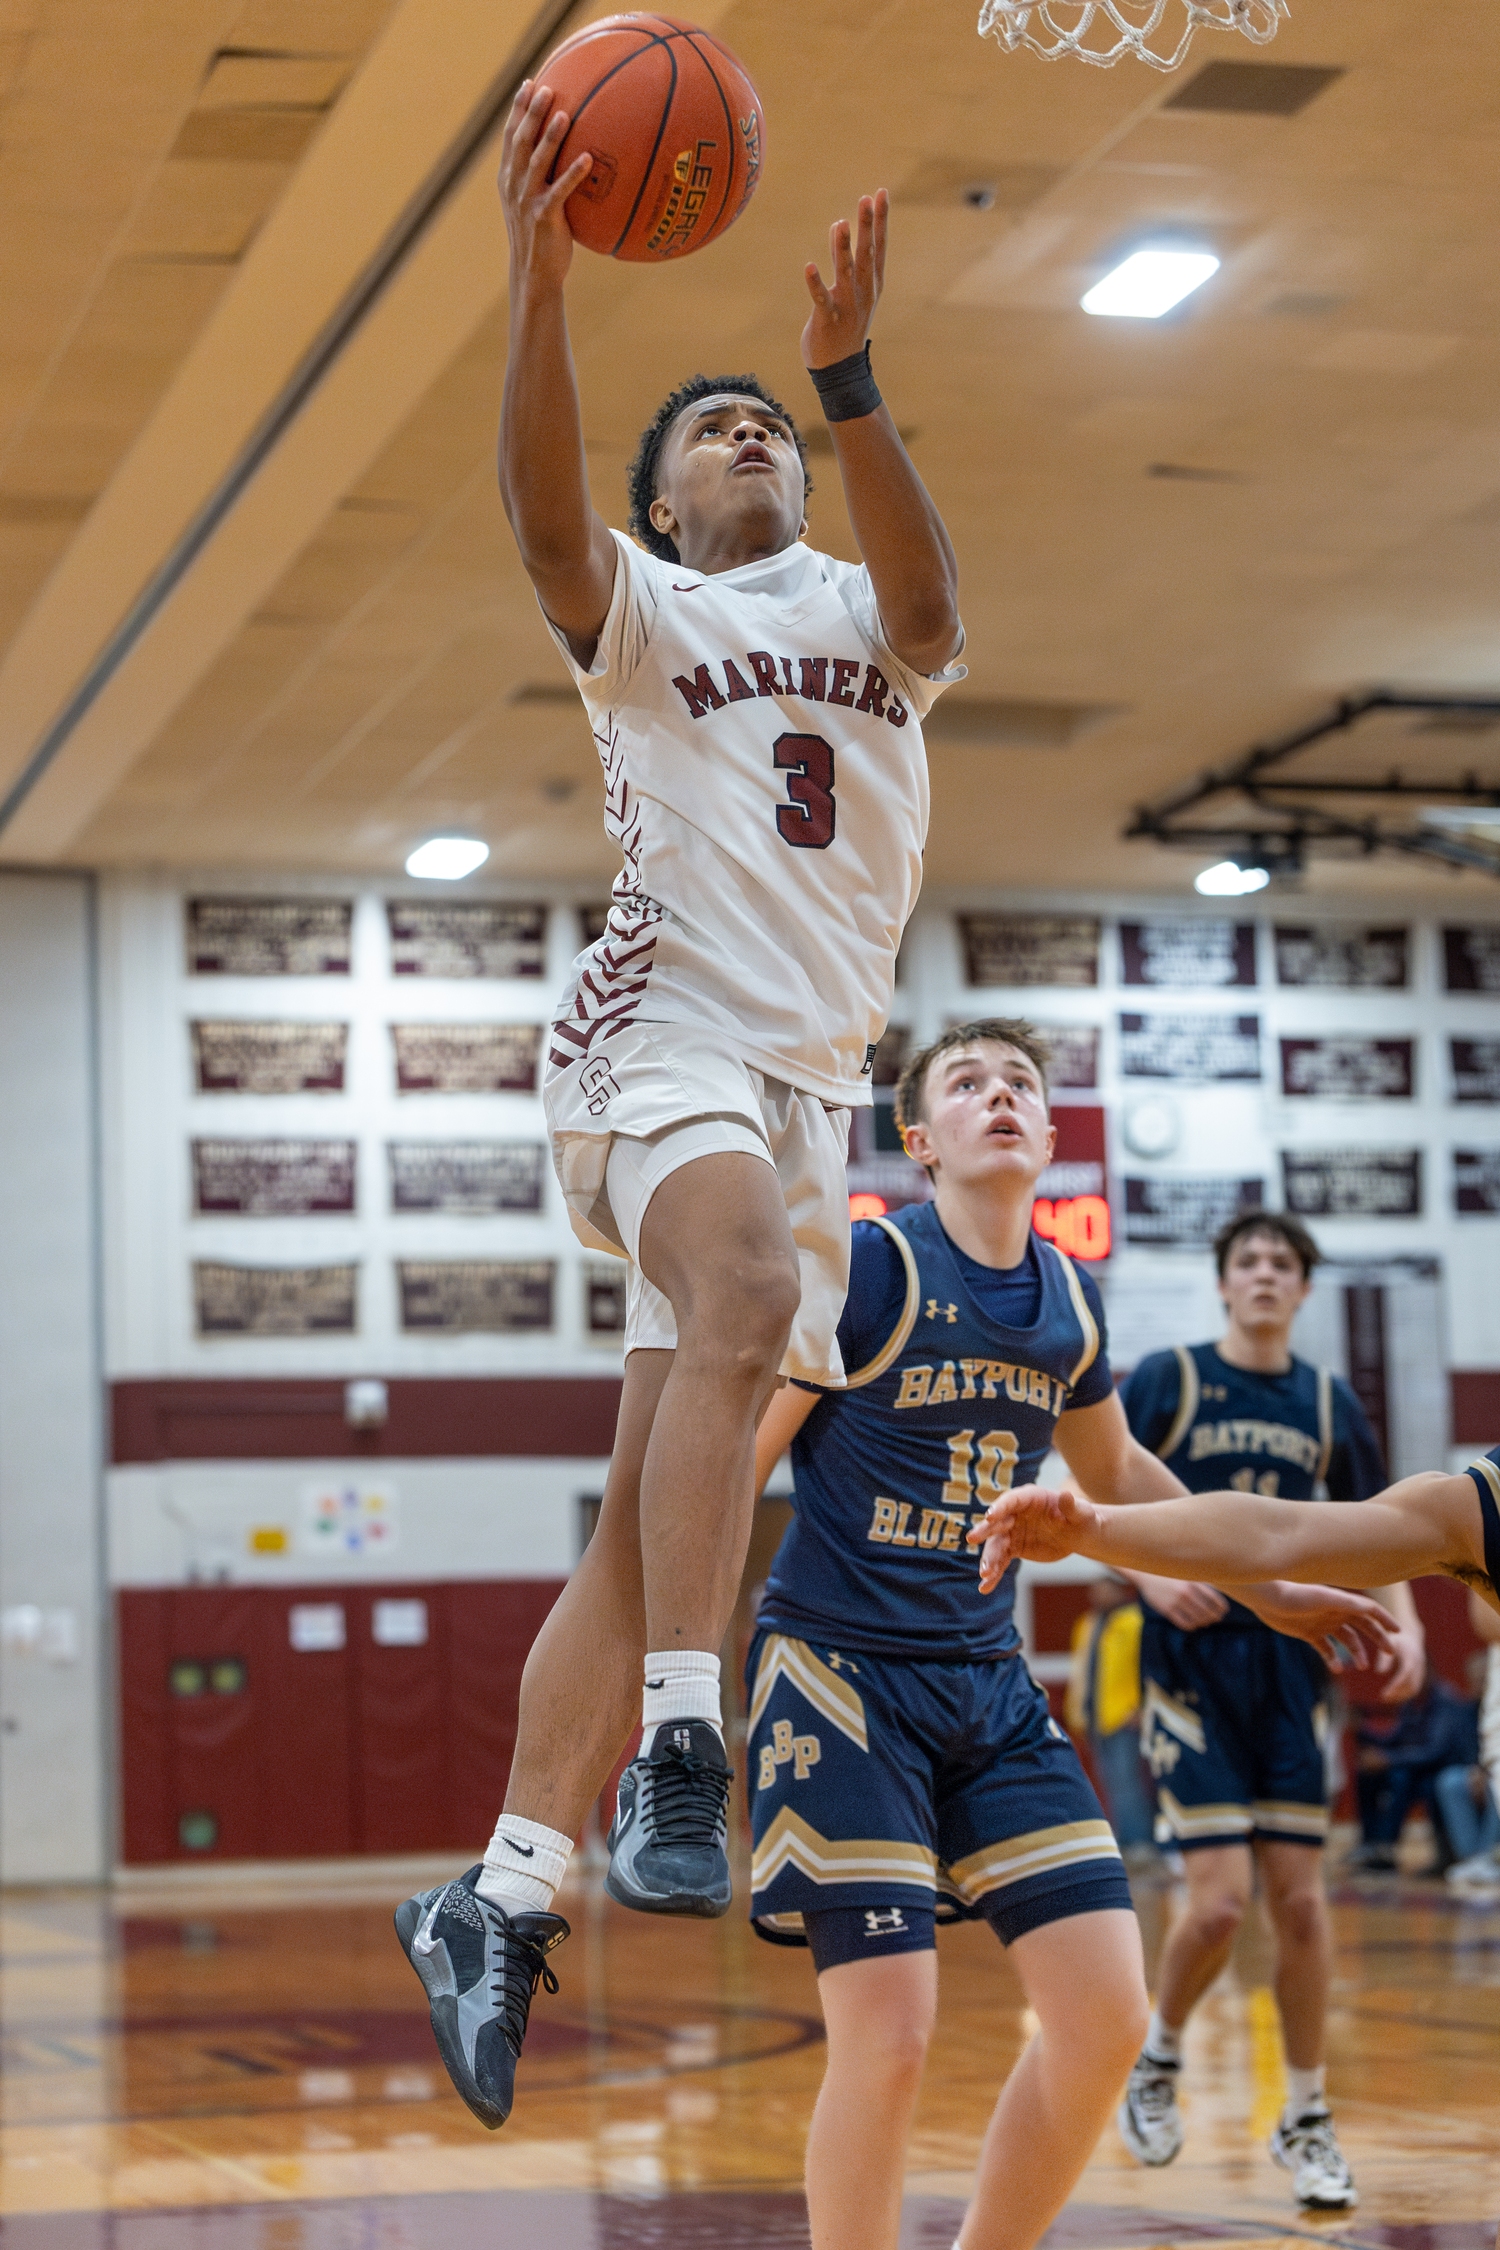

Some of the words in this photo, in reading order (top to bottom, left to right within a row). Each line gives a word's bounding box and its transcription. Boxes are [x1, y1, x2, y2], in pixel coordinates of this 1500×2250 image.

[671, 651, 909, 729] MARINERS
[772, 731, 837, 850] 3
[893, 1358, 1068, 1417] BAYPORT
[941, 1429, 1020, 1507] 10
[867, 1496, 966, 1552] BLUE
